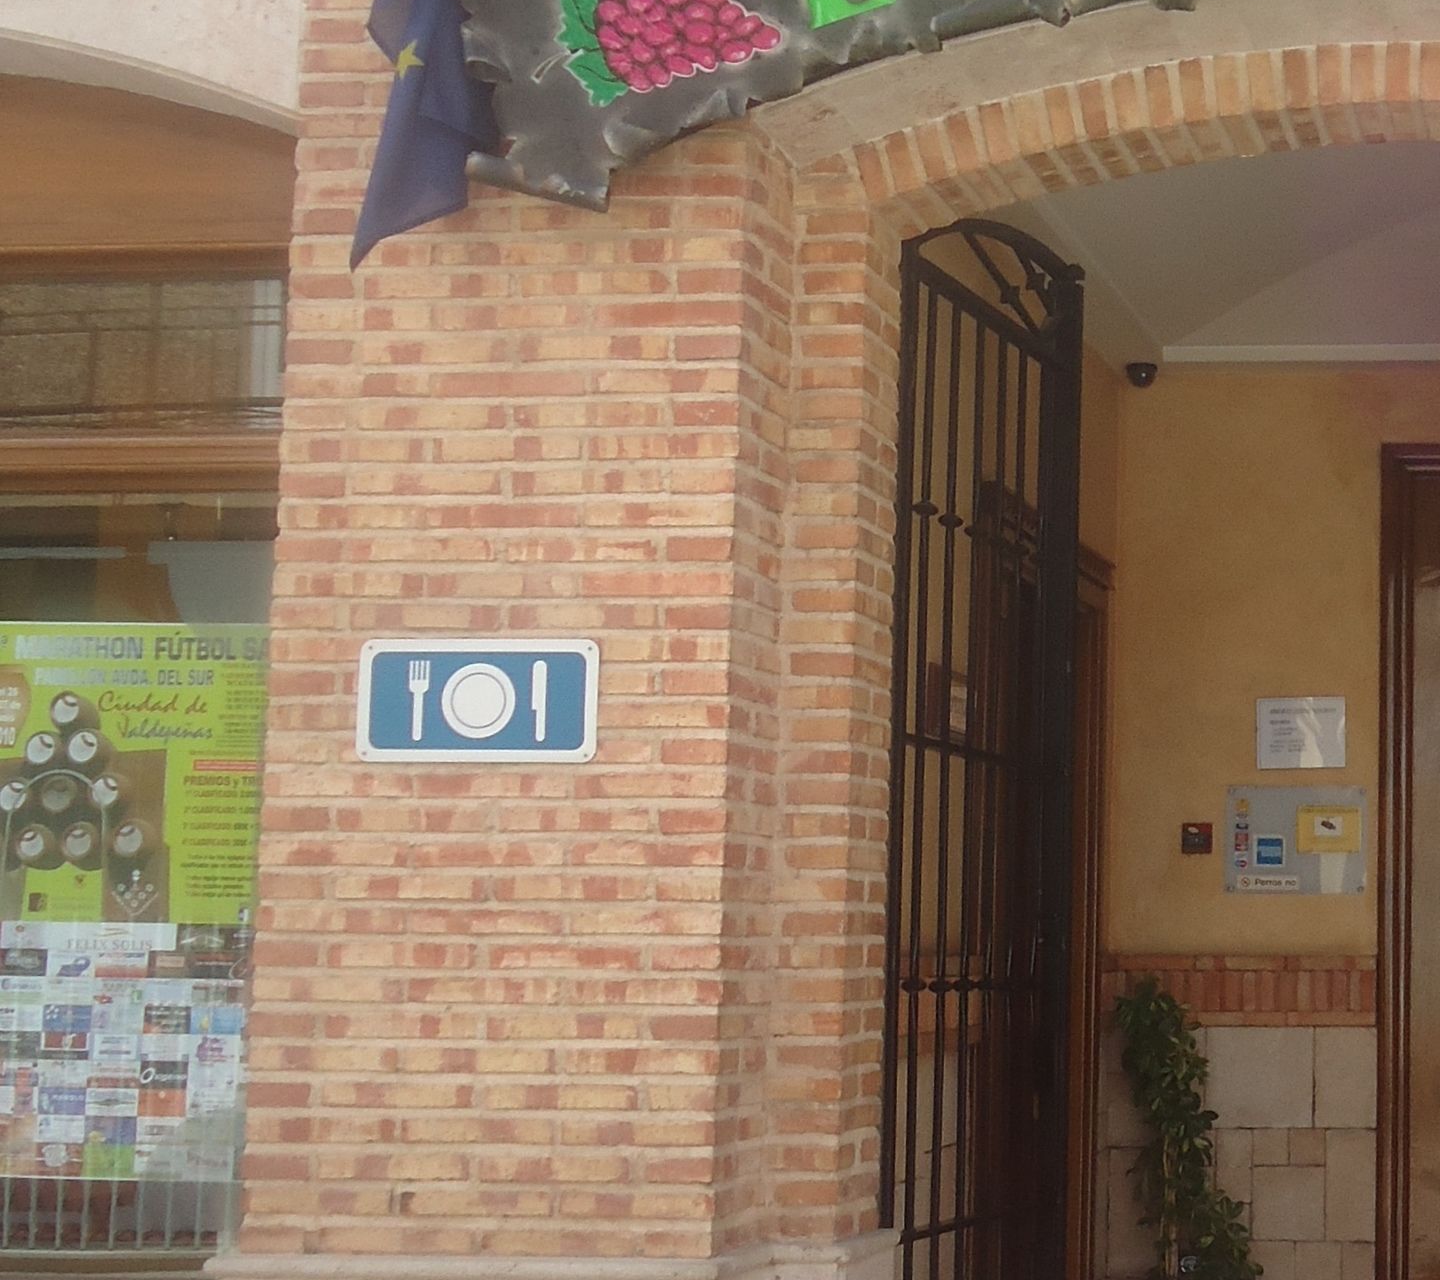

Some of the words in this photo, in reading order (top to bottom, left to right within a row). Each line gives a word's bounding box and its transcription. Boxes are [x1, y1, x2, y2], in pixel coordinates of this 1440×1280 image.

[154, 631, 237, 660] FÚTBOL
[157, 668, 183, 686] DEL
[188, 668, 214, 686] SUR
[98, 690, 177, 714] Ciudad
[185, 691, 208, 714] de
[1254, 875, 1282, 887] Perros
[1285, 878, 1297, 887] no
